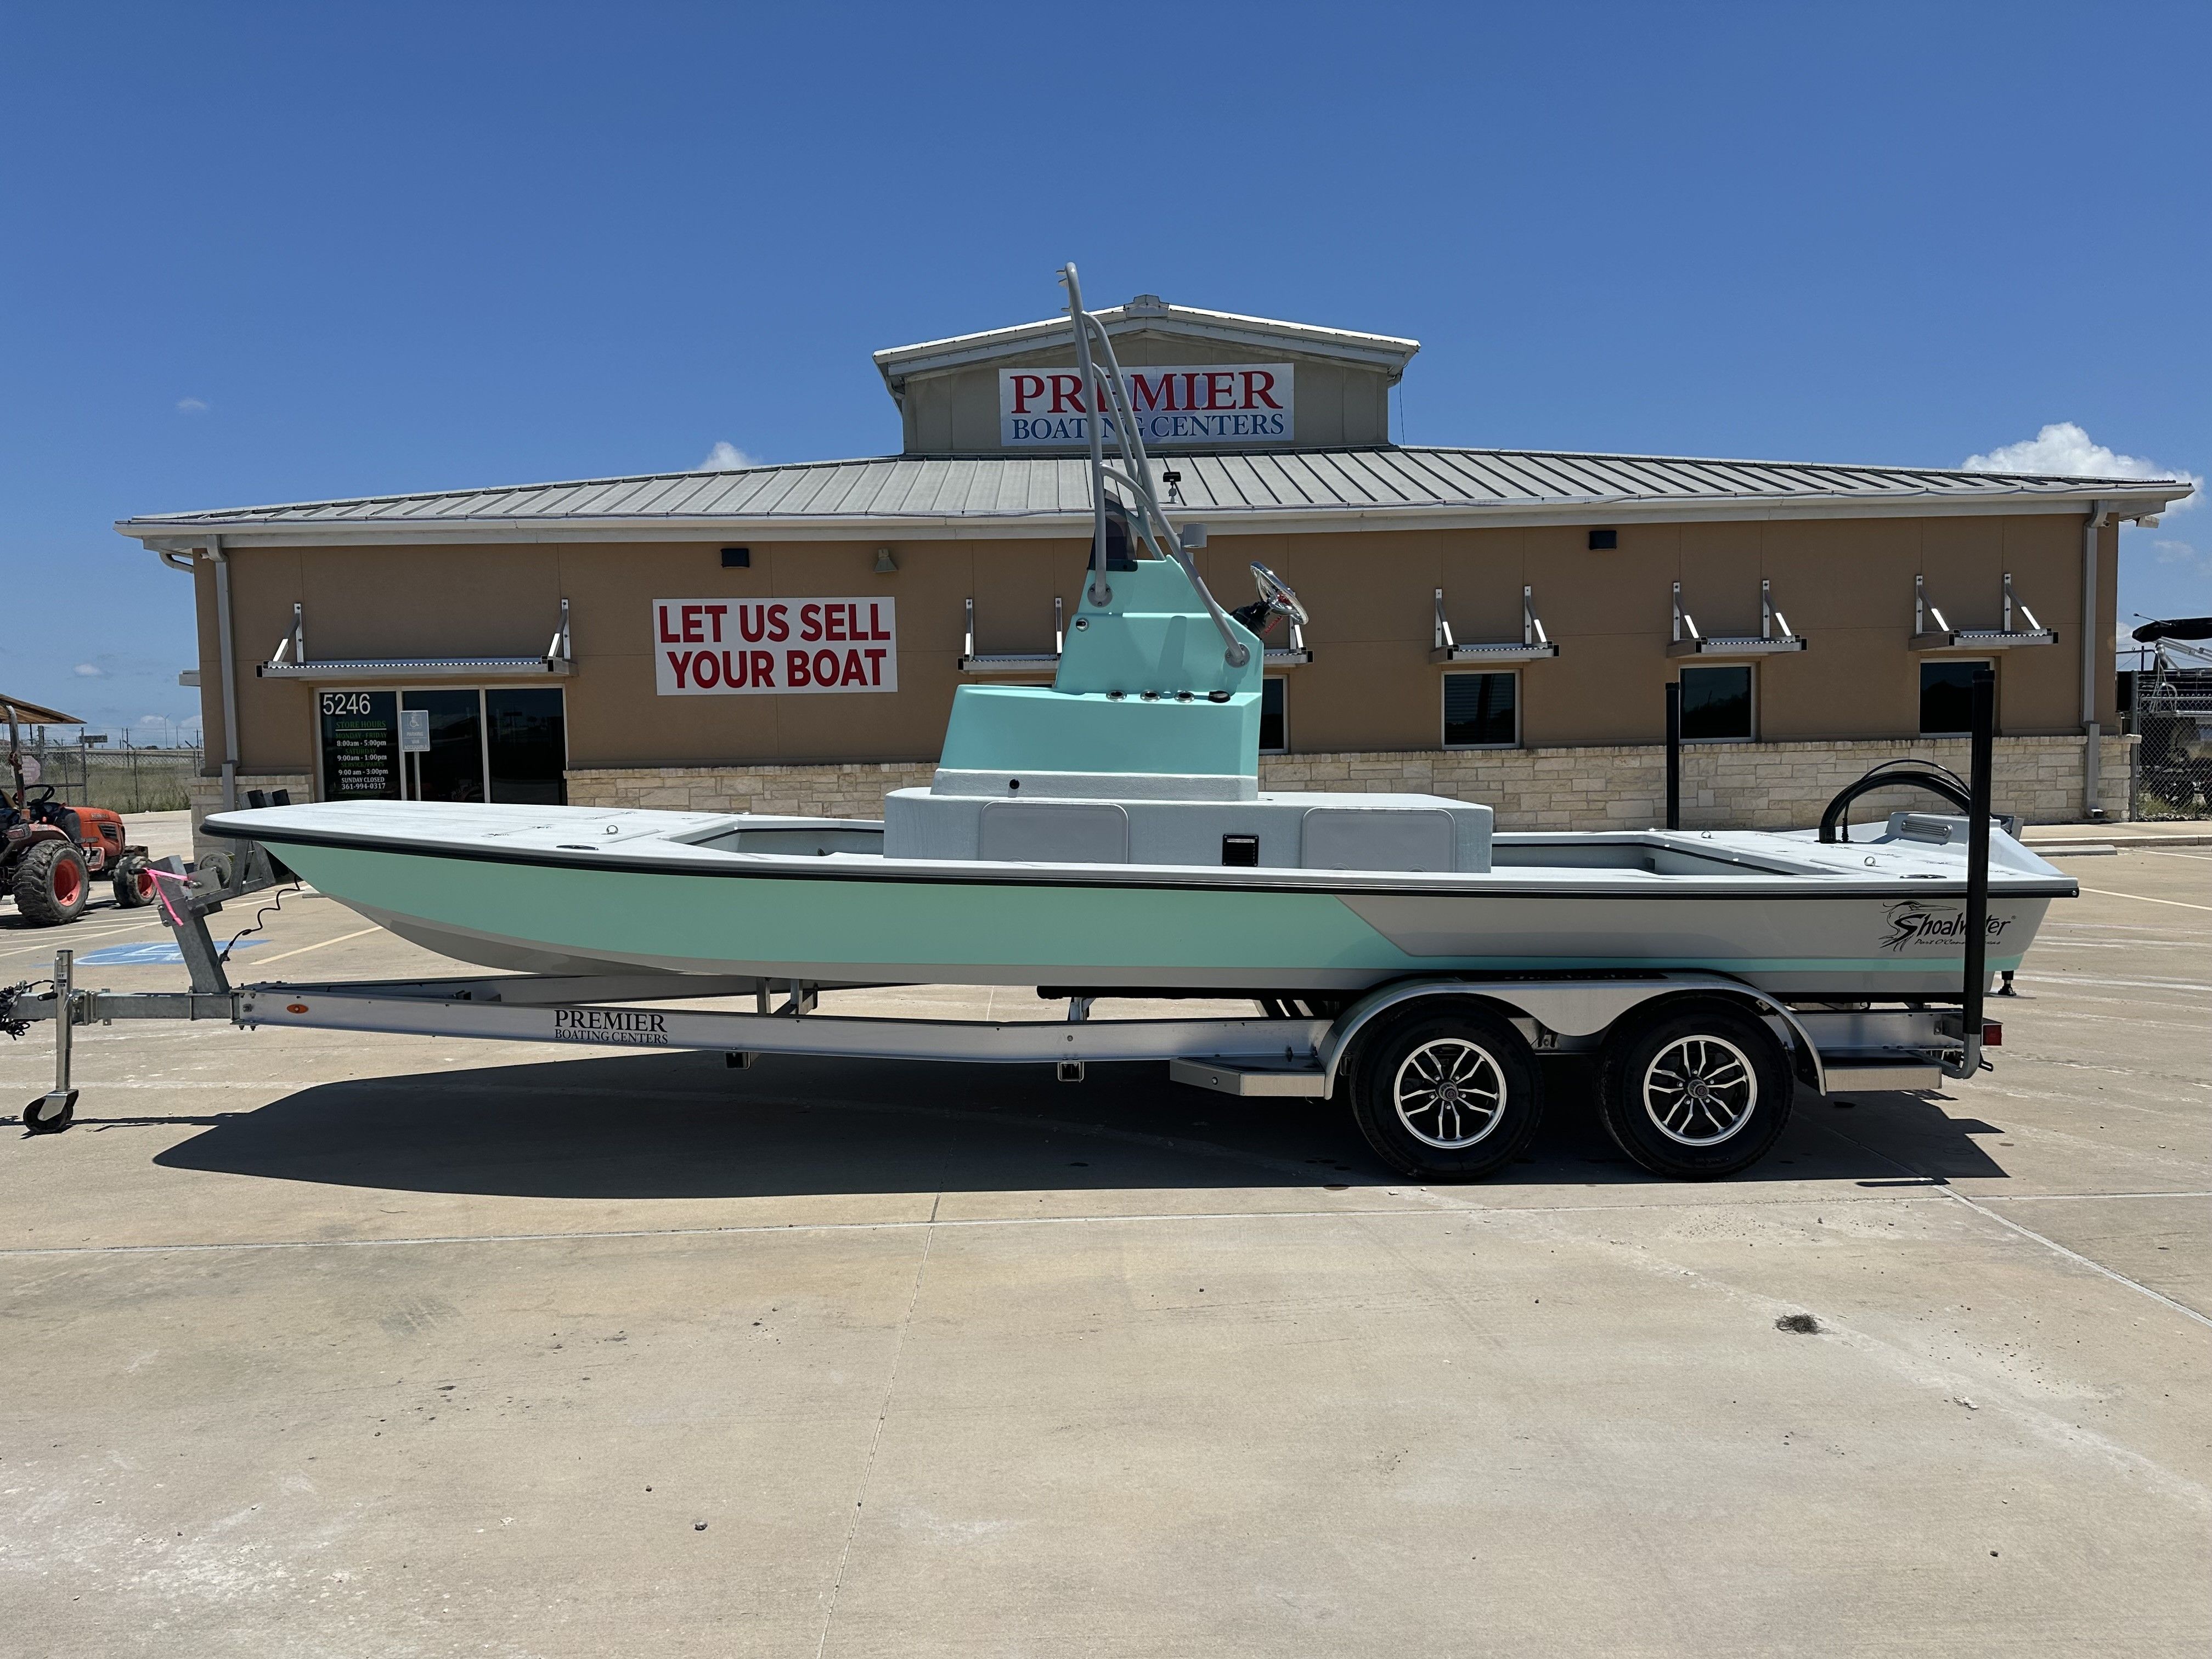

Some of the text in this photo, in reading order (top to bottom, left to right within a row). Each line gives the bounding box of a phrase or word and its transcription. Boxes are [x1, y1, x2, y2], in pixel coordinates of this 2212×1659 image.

[1012, 414, 1285, 439] BOATNG CENTERS
[659, 603, 891, 643] LET US SELL
[667, 648, 887, 689] YOUR BOAT
[323, 693, 371, 715] 5246
[361, 720, 386, 728] HOURS
[1893, 912, 2011, 939] Shoalter
[554, 1009, 668, 1033] PREMIER
[555, 1029, 668, 1045] BOATING CENTERS
